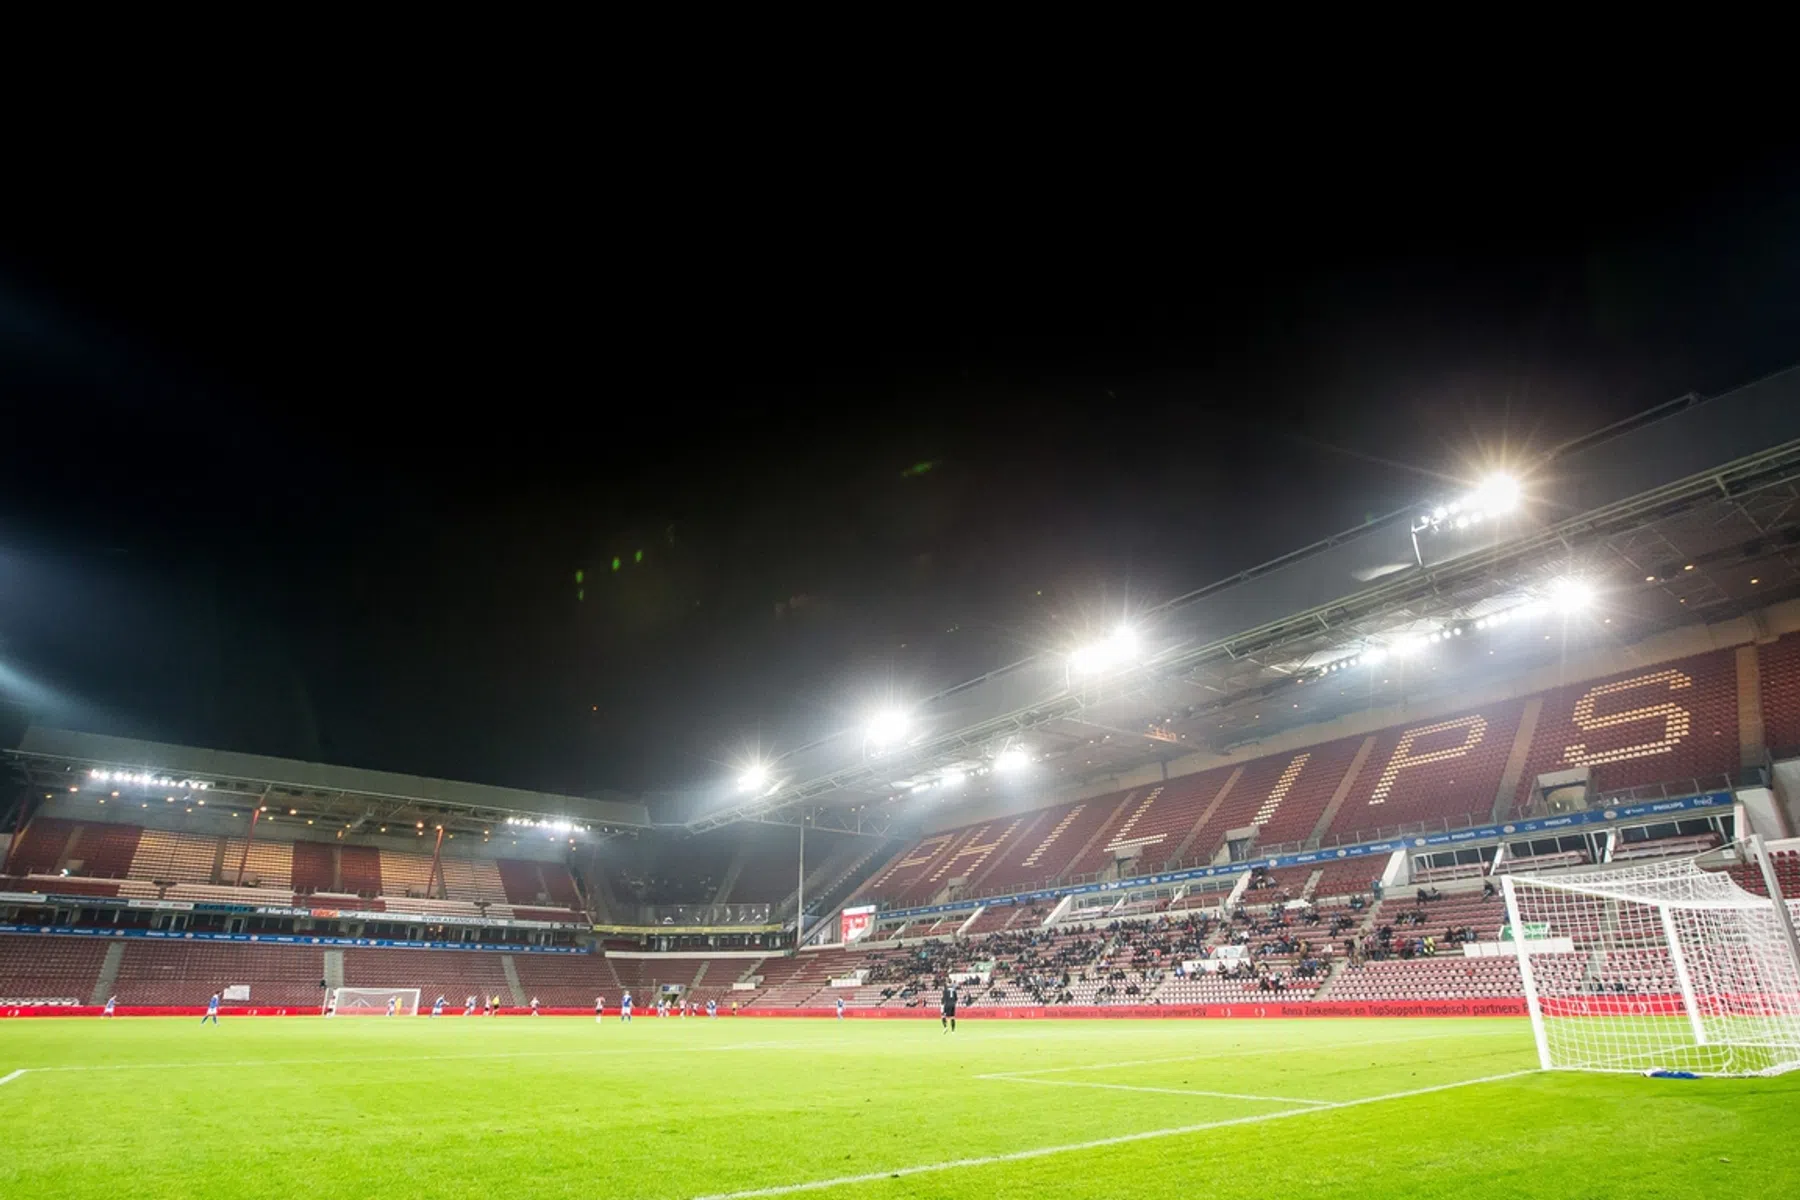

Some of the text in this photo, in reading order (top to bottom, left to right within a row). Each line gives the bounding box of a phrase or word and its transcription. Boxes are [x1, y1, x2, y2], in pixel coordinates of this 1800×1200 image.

[874, 668, 1692, 888] PHILIPS
[1652, 801, 1684, 811] PHILIPS
[1193, 1007, 1207, 1016] PSV
[1281, 1006, 1302, 1015] Anna
[1305, 1006, 1352, 1015] Ziekenhuis
[1368, 1005, 1422, 1017] TopSupport
[1426, 1004, 1469, 1014] medisch
[1473, 1004, 1520, 1016] partners
